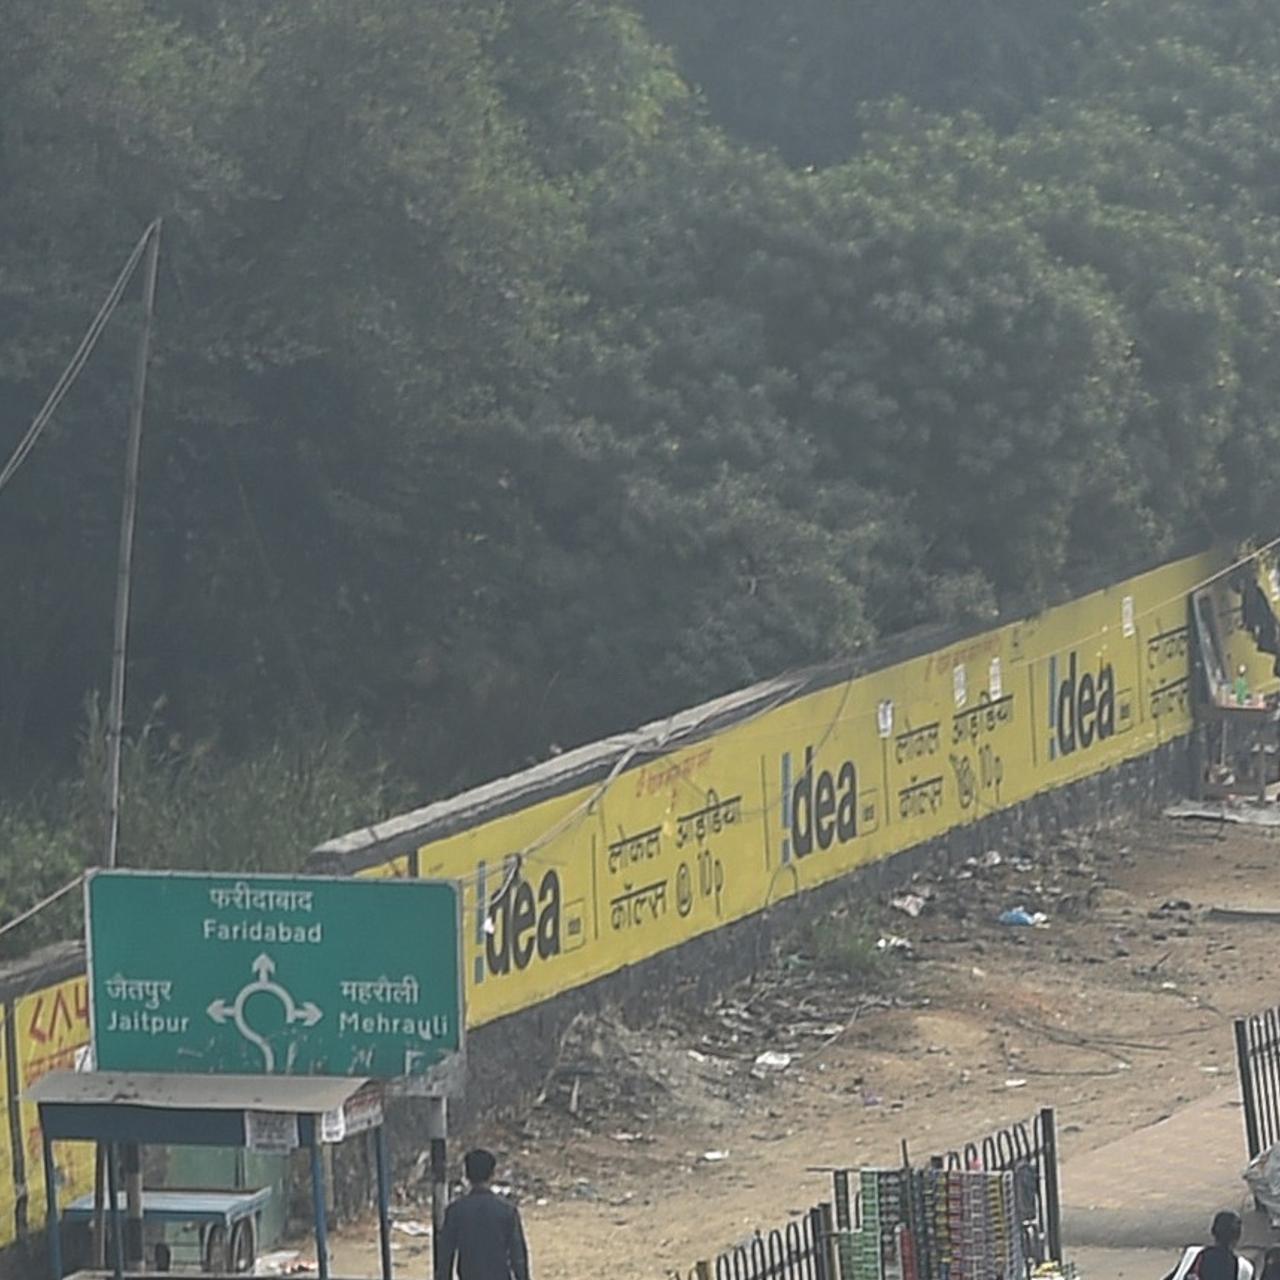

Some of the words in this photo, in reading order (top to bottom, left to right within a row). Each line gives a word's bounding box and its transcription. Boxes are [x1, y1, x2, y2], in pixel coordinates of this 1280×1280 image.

[210, 882, 314, 913] फरीदाबाद
[610, 880, 668, 931] कॉल्स
[203, 919, 323, 944] Faridabad
[105, 972, 173, 1008] जैतपुर
[341, 975, 420, 1005] महरौली
[106, 1011, 190, 1036] Jaitpur
[340, 1011, 449, 1041] Mehrauli
